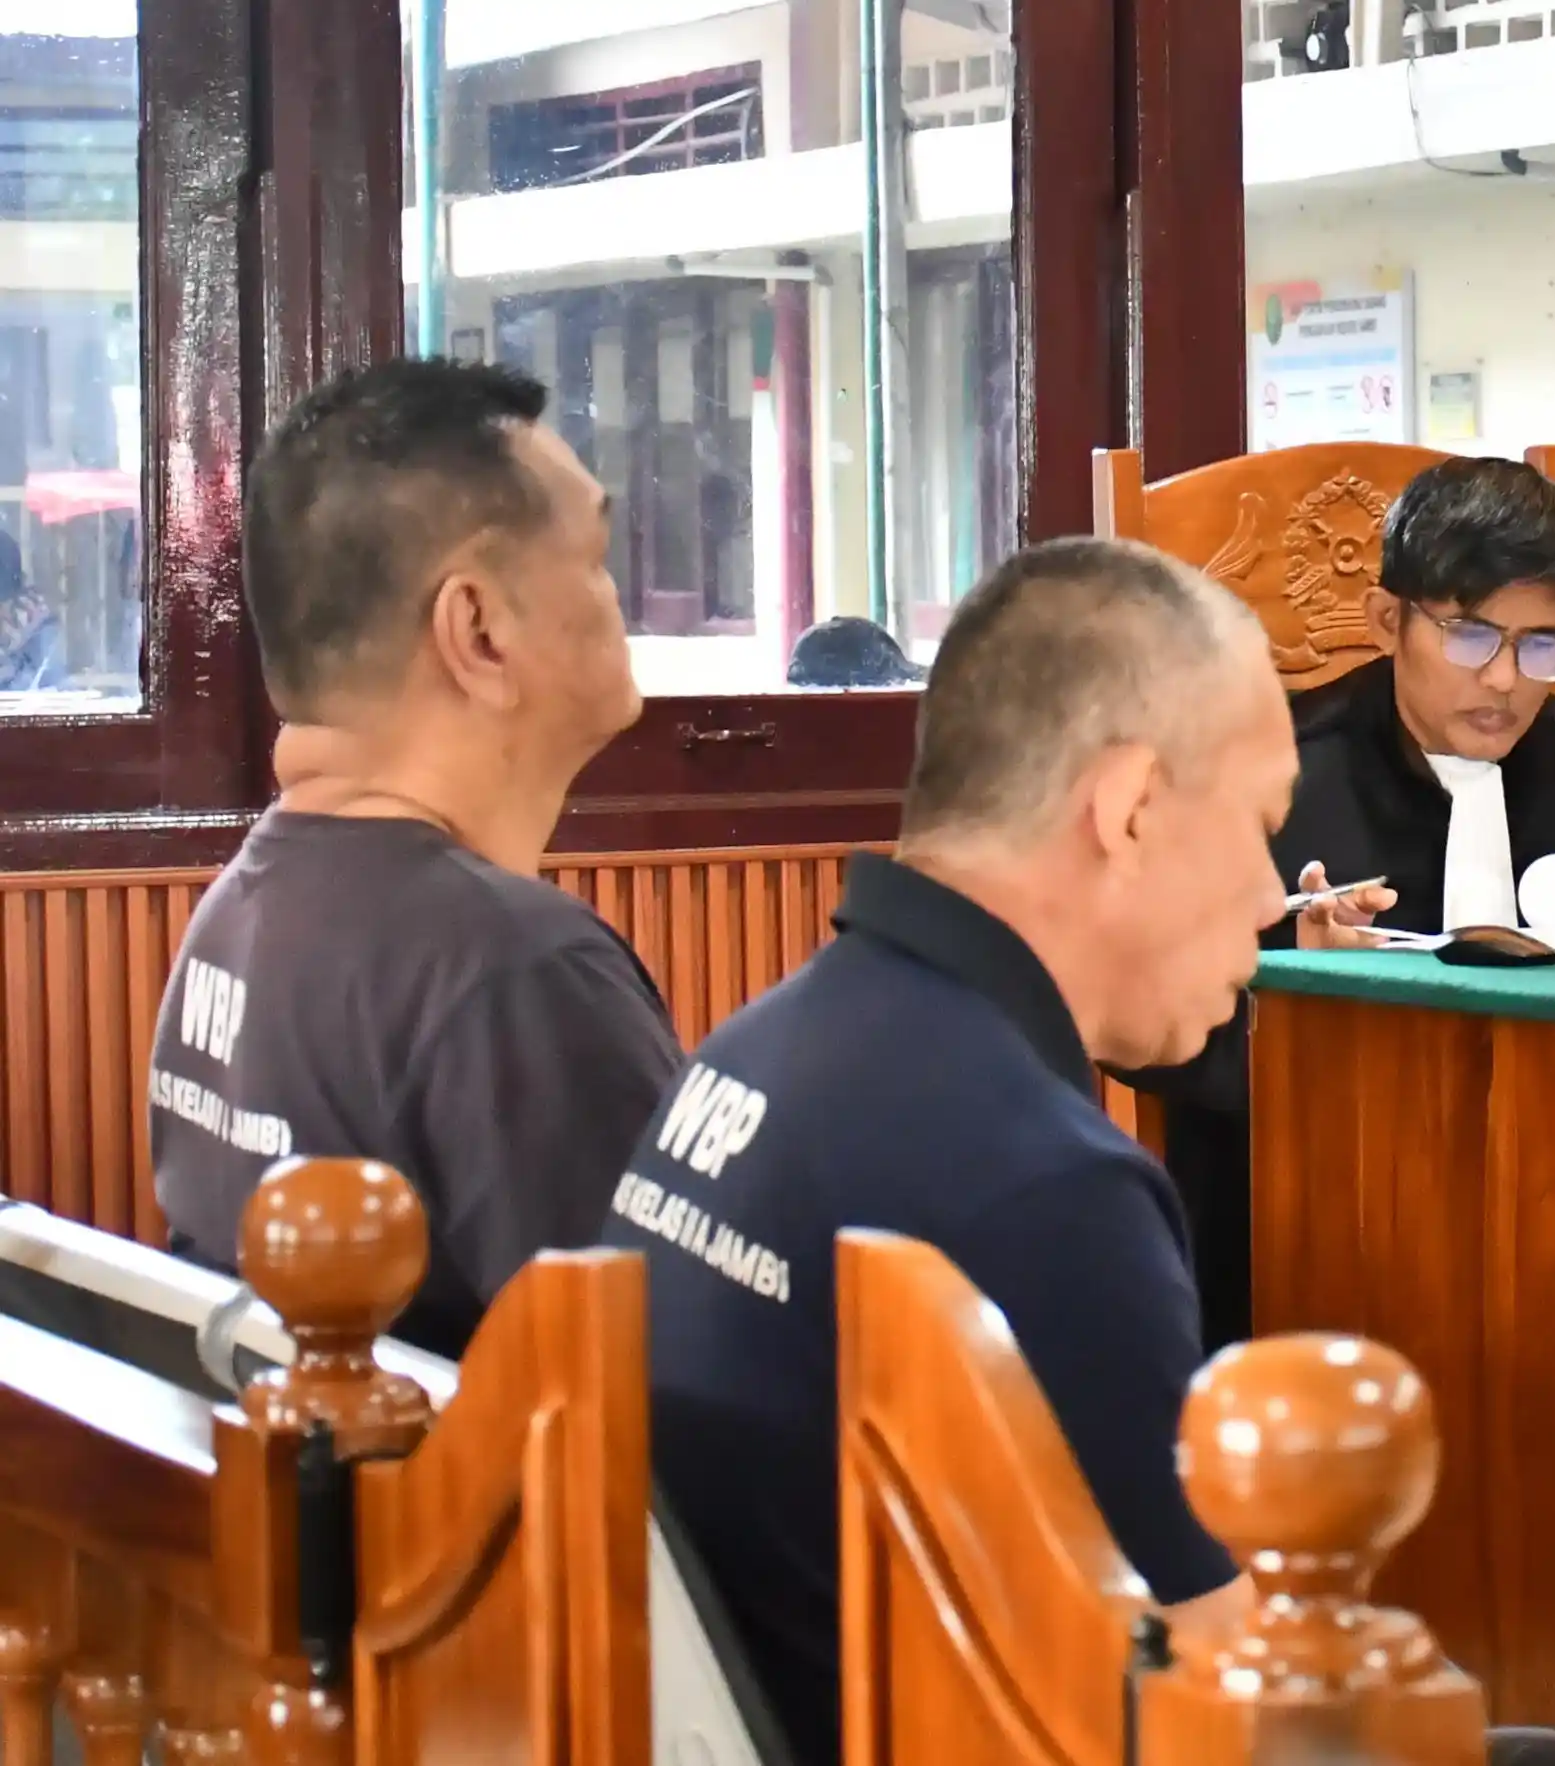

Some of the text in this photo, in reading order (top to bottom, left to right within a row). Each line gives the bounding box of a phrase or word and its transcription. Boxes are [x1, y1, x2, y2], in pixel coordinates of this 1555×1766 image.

[181, 957, 247, 1067] WBP
[656, 1061, 768, 1180] WBP
[705, 1222, 790, 1304] JAMBI
